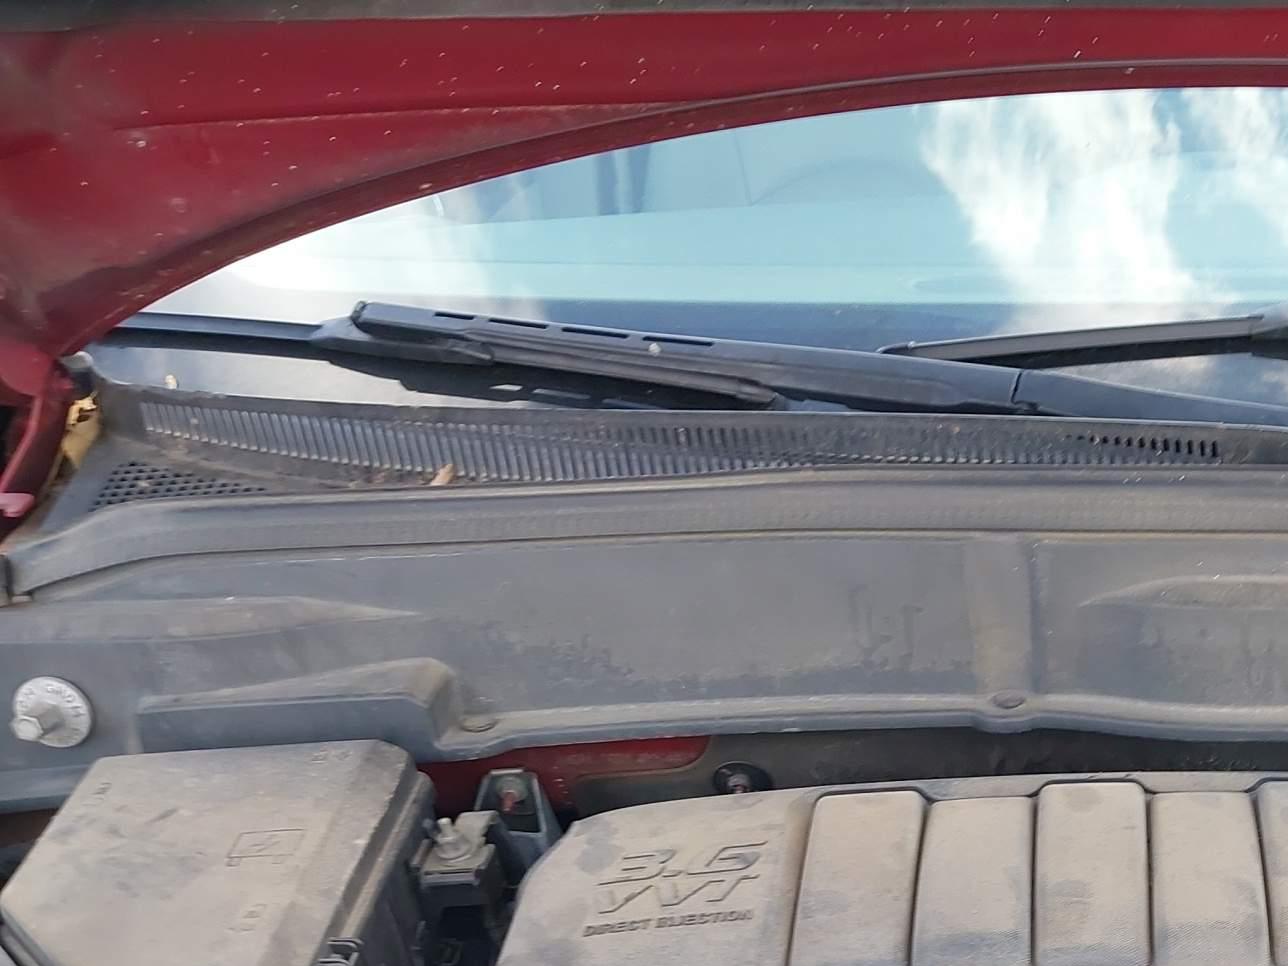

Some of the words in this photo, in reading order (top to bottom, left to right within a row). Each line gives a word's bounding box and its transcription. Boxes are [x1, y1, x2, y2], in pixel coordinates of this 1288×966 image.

[596, 838, 769, 887] 3.6
[594, 873, 761, 915] VVT
[582, 917, 653, 938] DIRECT
[654, 908, 755, 930] INJECTION
